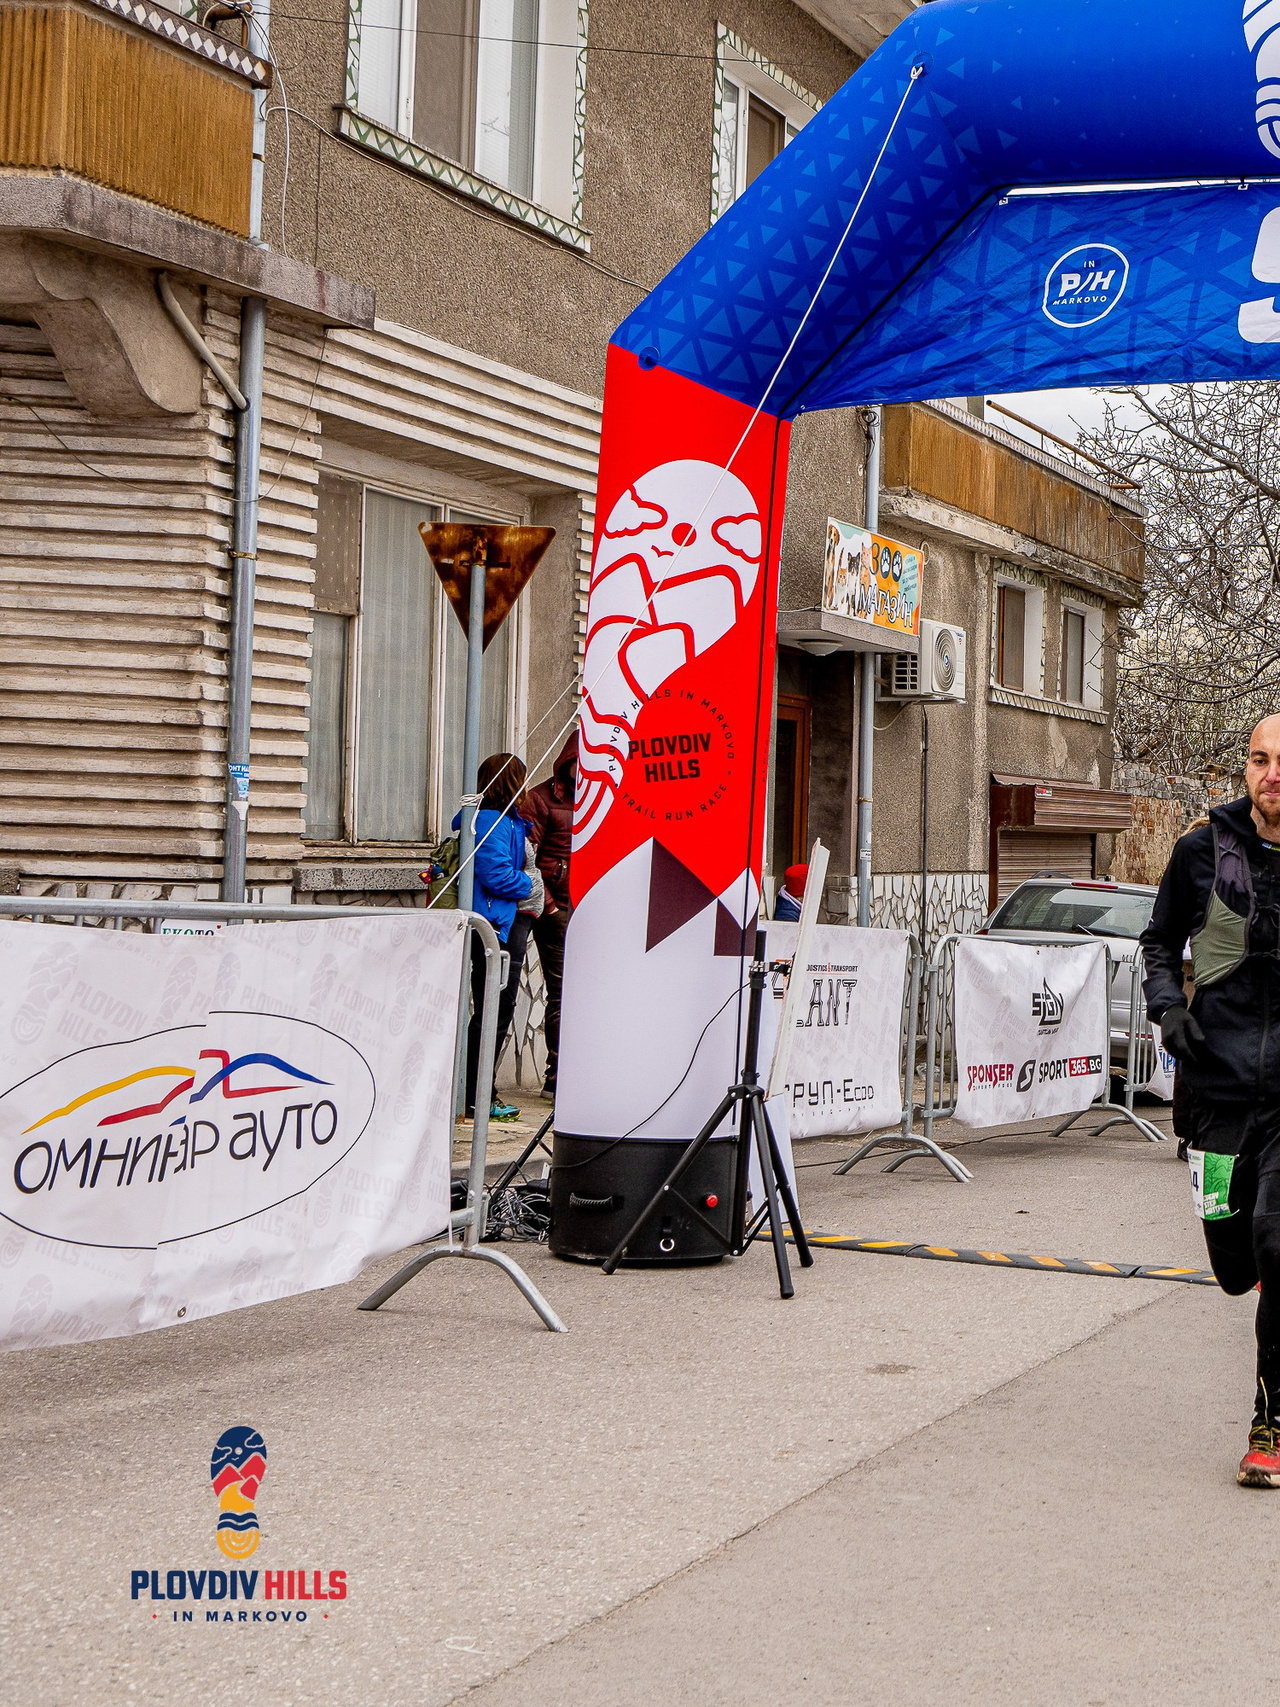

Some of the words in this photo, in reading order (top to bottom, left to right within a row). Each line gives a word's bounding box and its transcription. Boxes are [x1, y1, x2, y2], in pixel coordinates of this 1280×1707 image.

[1083, 260, 1096, 268] IN
[1058, 270, 1116, 297] P/H
[1052, 295, 1107, 305] MARKOVO
[858, 583, 913, 628] МАГАЗИН
[609, 711, 629, 772] PLOVDIV
[631, 689, 671, 709] HILLS
[680, 689, 694, 701] IN
[701, 698, 735, 759] MARKOVO
[628, 732, 711, 760] PLOVDIV
[644, 759, 701, 783] HILLS
[622, 793, 656, 819] TRAIL
[665, 810, 694, 821] RUN
[700, 784, 727, 812] RACE
[1038, 1058, 1068, 1084] SPORT
